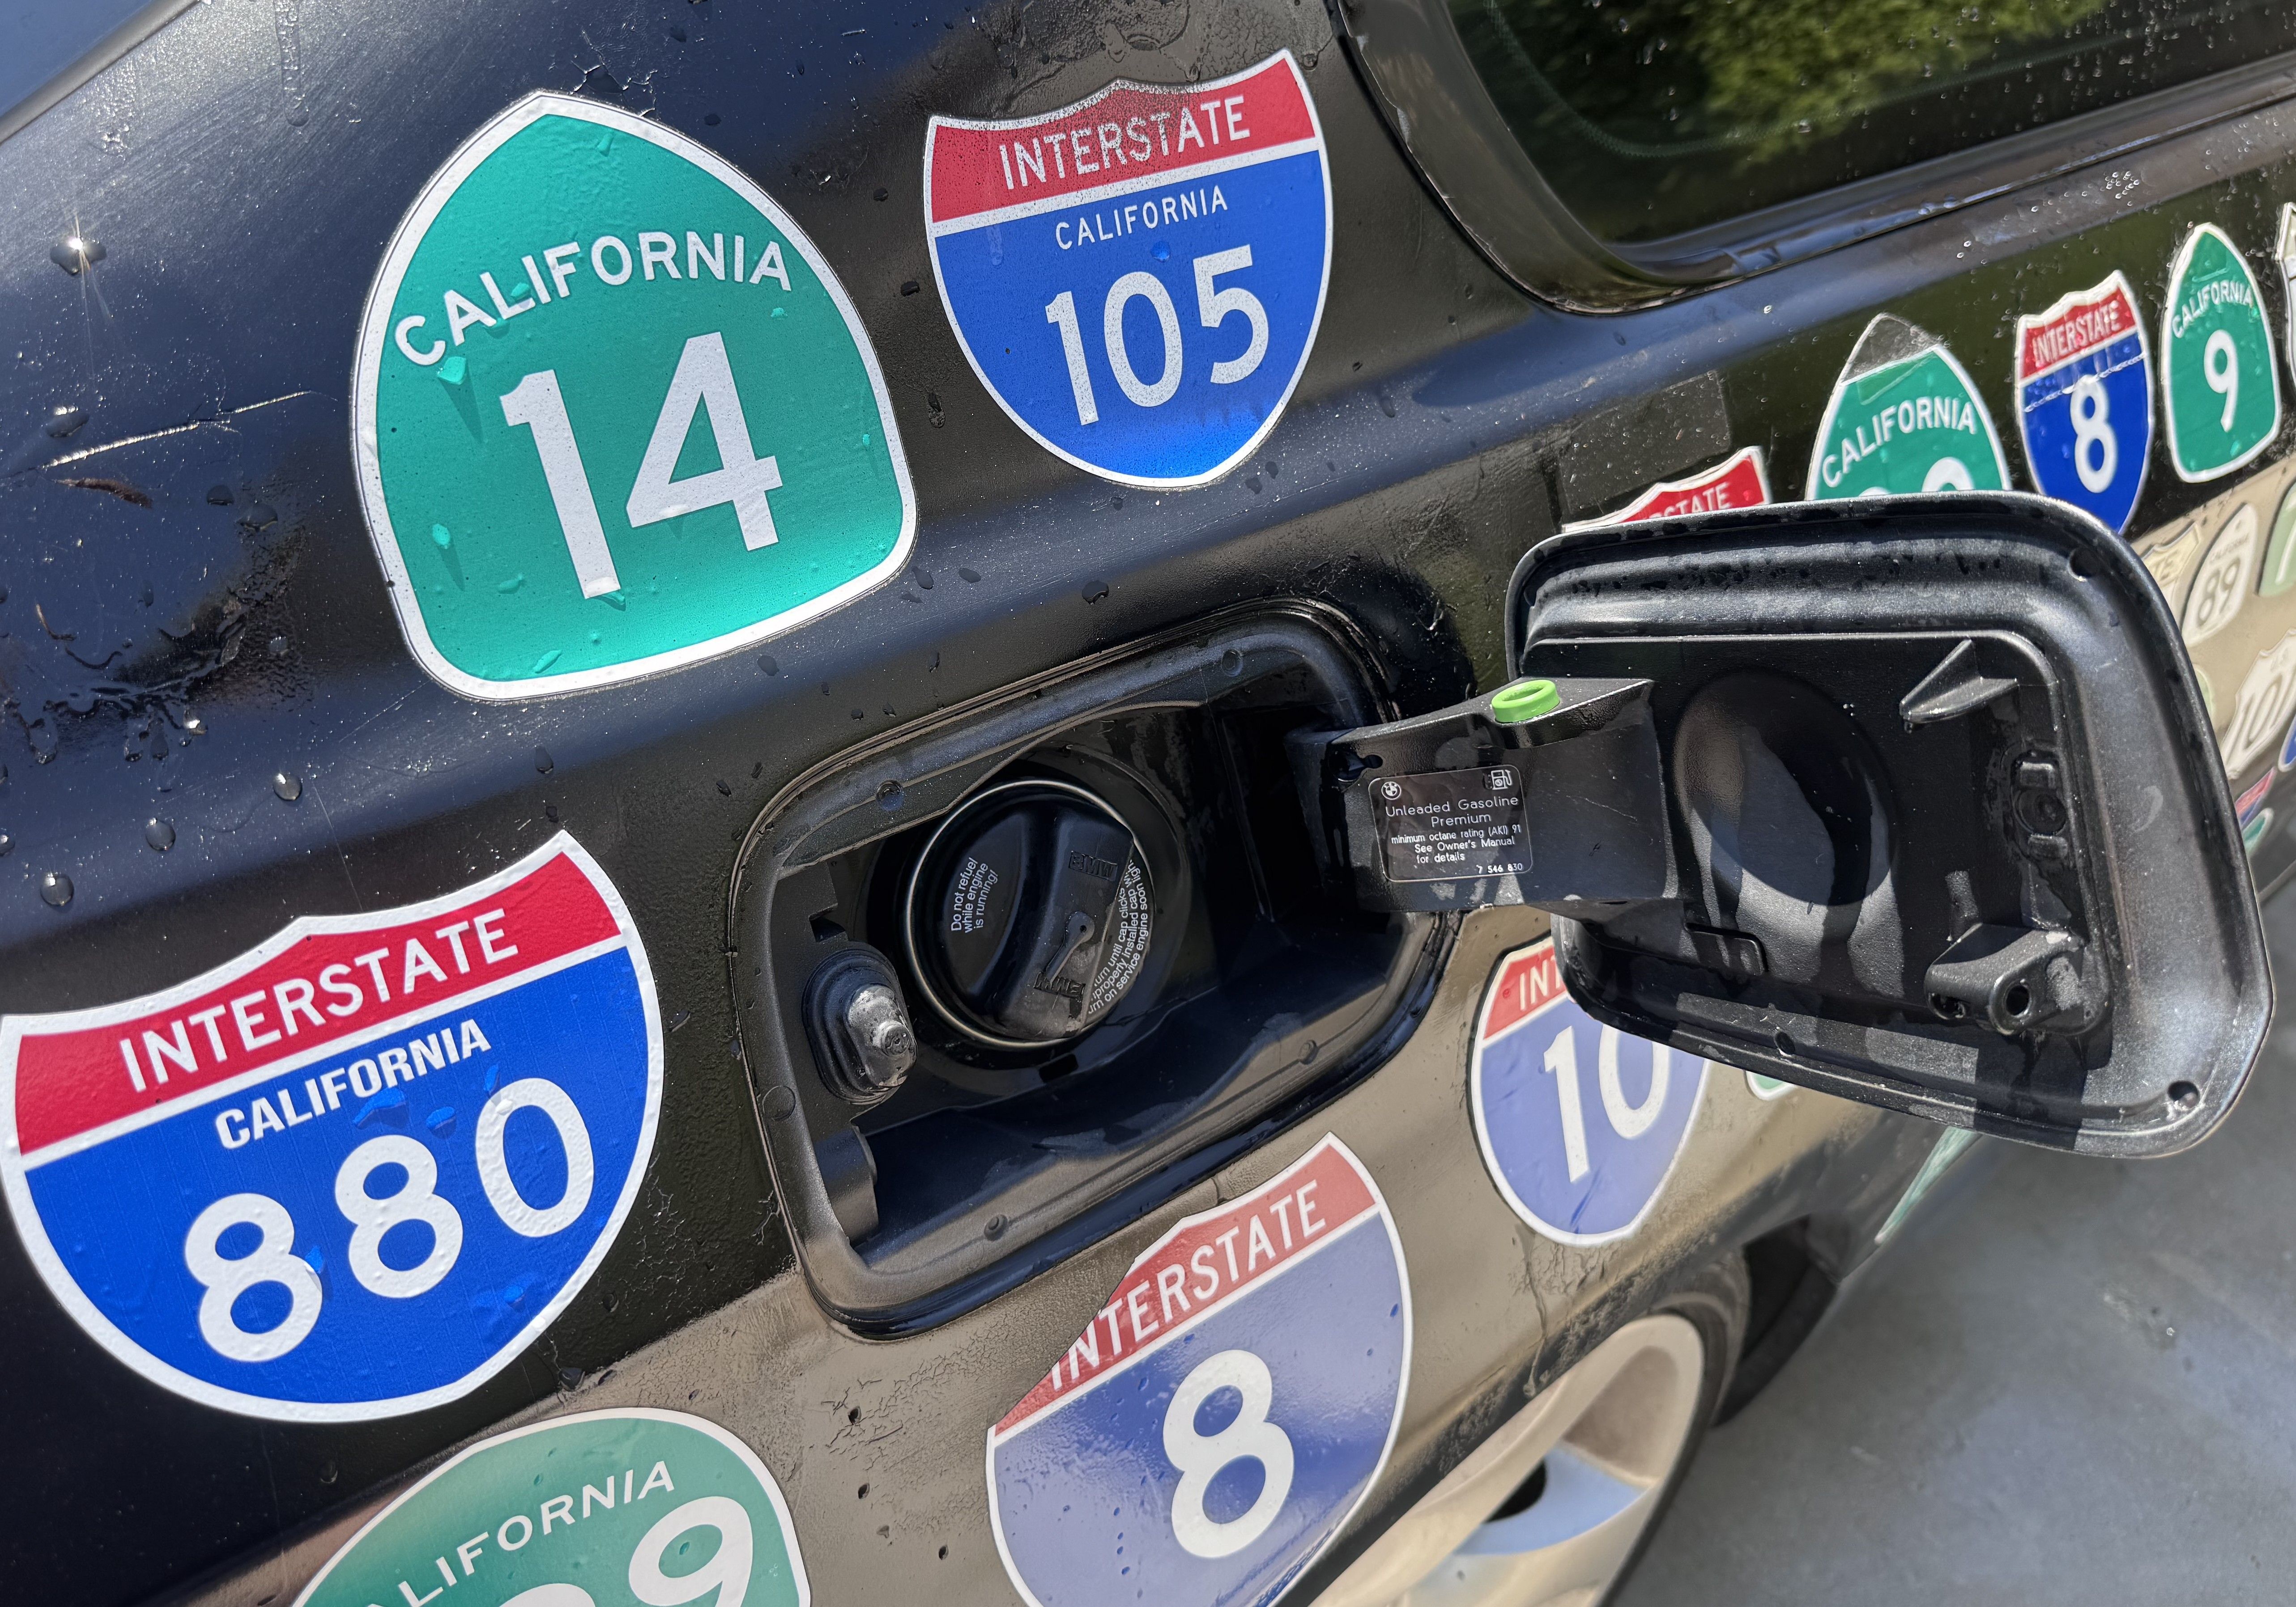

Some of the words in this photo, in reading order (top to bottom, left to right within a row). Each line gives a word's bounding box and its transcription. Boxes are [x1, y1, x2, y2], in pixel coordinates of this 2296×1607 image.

[999, 95, 1250, 190] INTERSTATE
[1056, 185, 1228, 249] CALIFORNIA
[394, 231, 792, 366] CALIFORNIA
[2172, 279, 2254, 339] CALIFORNIA
[1044, 244, 1269, 425] 105
[2032, 301, 2122, 368] INTERSTATE
[2204, 330, 2238, 432] 9
[1822, 396, 1977, 488] CALIFORNIA
[2070, 374, 2117, 493] 8
[499, 331, 783, 599] 14
[2196, 558, 2241, 625] 89
[1385, 801, 1450, 817] Unleaded
[1458, 796, 1519, 810] Gasoline
[1431, 813, 1491, 827] Premium
[1391, 834, 1425, 844] minimum
[1429, 831, 1456, 841] octane
[1461, 829, 1484, 839] rating
[1488, 826, 1508, 837] (AKI)
[1512, 825, 1521, 833] 91
[1414, 844, 1432, 853] See
[1437, 839, 1476, 851] Owner's
[1481, 836, 1515, 847] Manual
[958, 857, 978, 890] refuel
[1128, 859, 1141, 883] ligh
[1417, 854, 1429, 864] for
[1434, 852, 1465, 863] details
[1476, 865, 1483, 874] 7
[1487, 865, 1504, 873] 546
[1508, 863, 1522, 871] 830
[967, 863, 988, 900] engine
[976, 869, 998, 915] running!
[1128, 889, 1138, 910] cap
[1136, 882, 1147, 910] soon
[954, 892, 965, 911] not
[962, 903, 974, 933] while
[1118, 888, 1128, 918] clicks
[951, 914, 962, 931] Do
[973, 918, 984, 929] is
[1119, 921, 1129, 942] cap
[1121, 912, 1139, 958] installed
[1136, 913, 1149, 951] engine
[1108, 943, 1123, 966] until
[1116, 952, 1140, 990] service
[1095, 967, 1110, 986] urn
[1104, 988, 1117, 1002] on
[119, 908, 519, 1093] INTERSTATE
[1088, 999, 1104, 1014] urn
[214, 1019, 491, 1149] CALIFORNIA
[1544, 1025, 1669, 1183] 10
[184, 1077, 594, 1362] 880
[1163, 1350, 1294, 1558] 8
[366, 1461, 675, 1607] LIFORNIA
